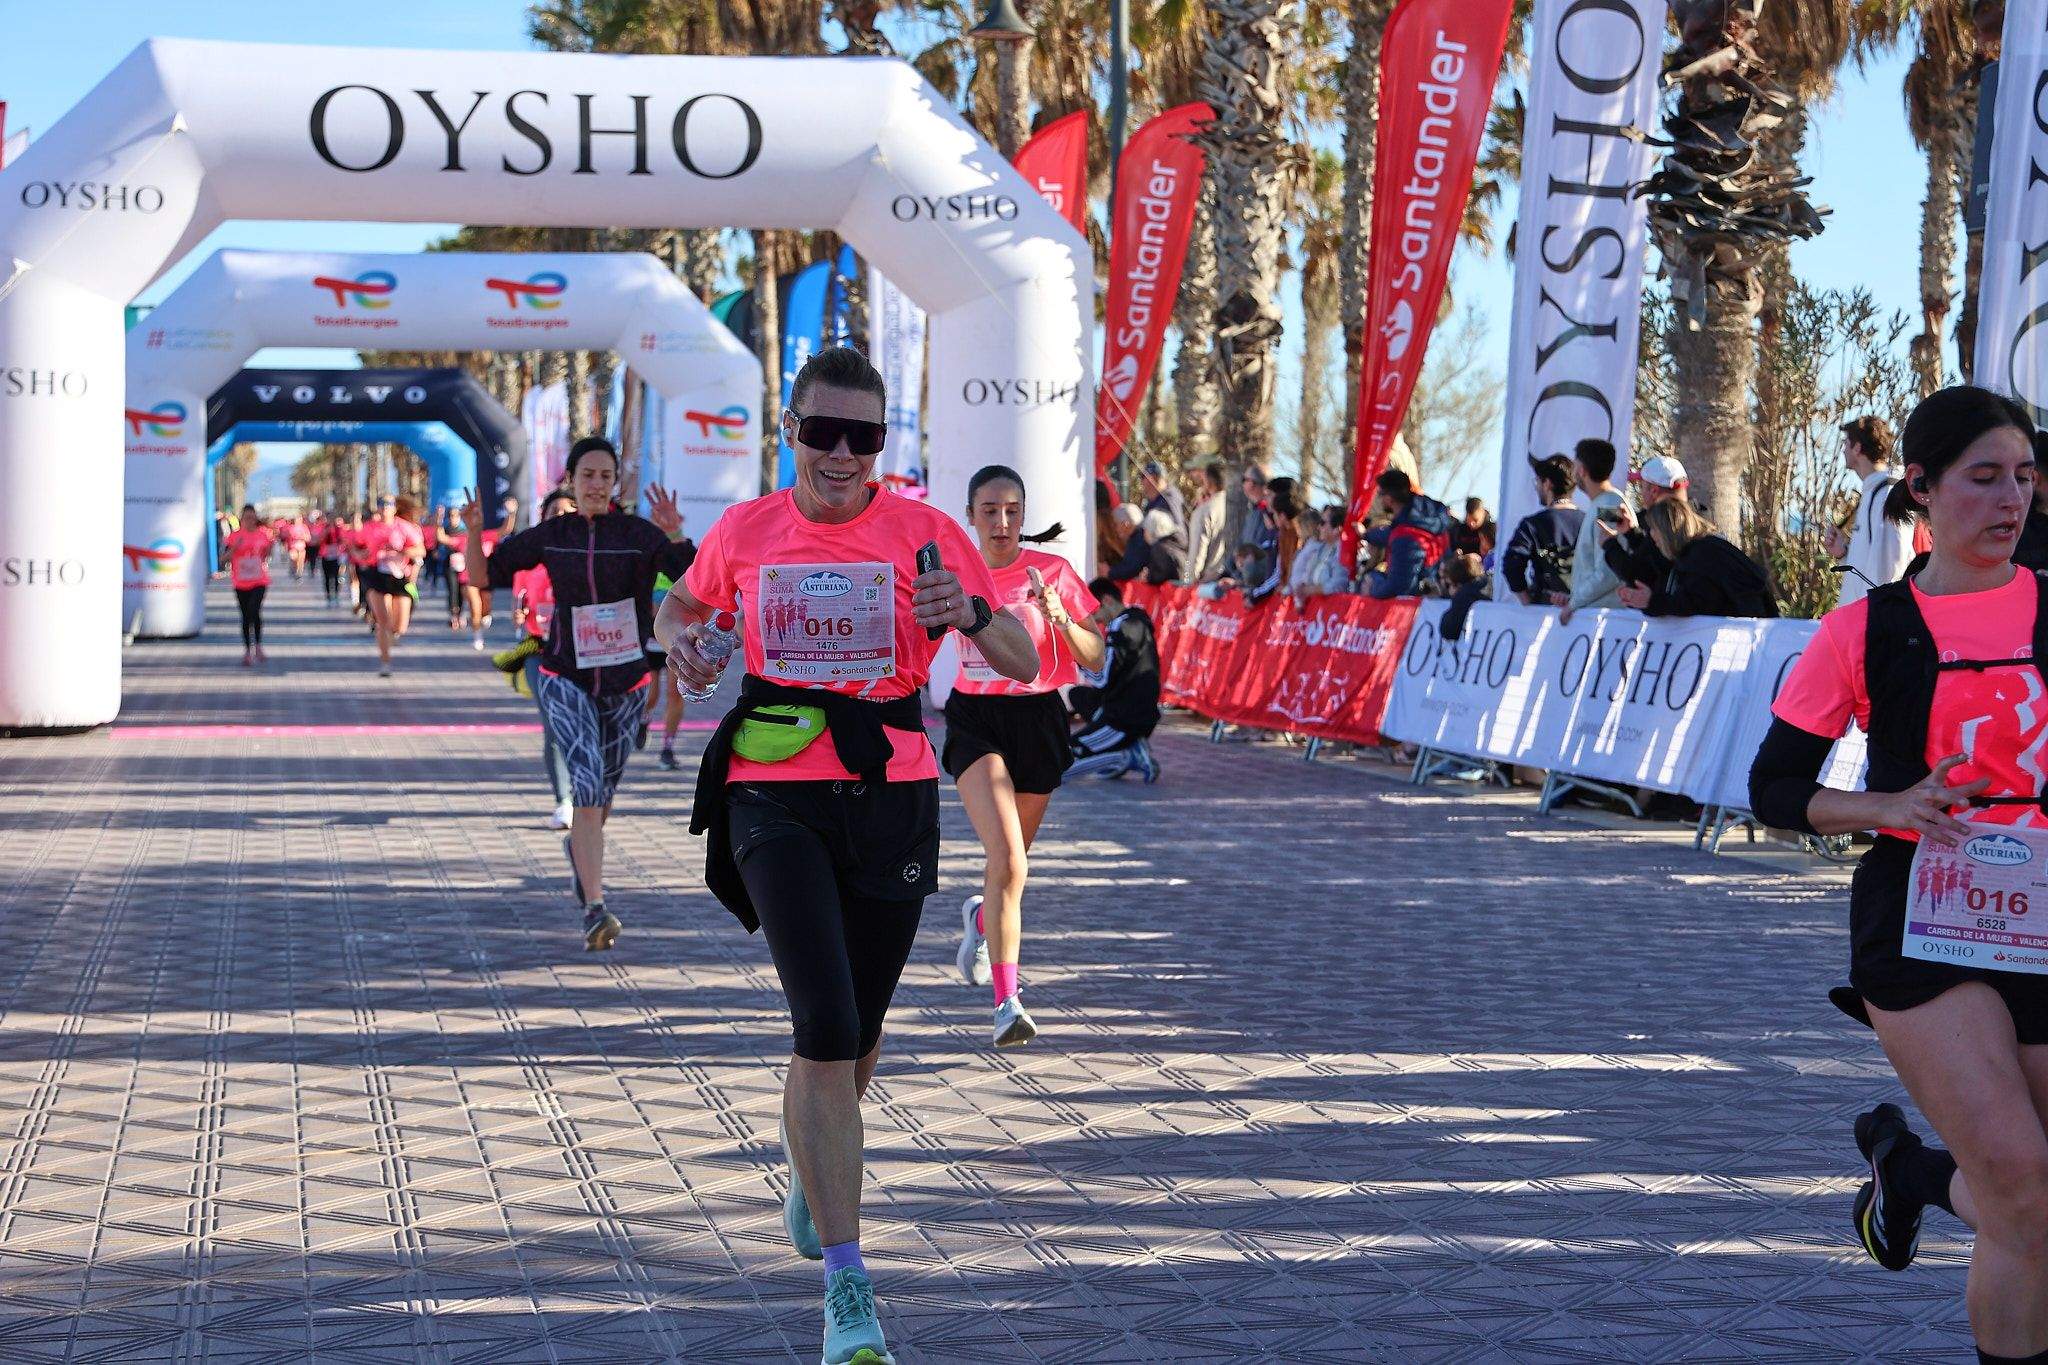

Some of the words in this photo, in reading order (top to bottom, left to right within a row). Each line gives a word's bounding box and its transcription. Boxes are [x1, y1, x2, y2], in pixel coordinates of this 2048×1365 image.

[310, 84, 763, 180] OYSHO
[1391, 29, 1468, 293] Santander
[22, 180, 165, 214] OYSHO
[892, 194, 1018, 223] OYSHO
[1528, 0, 1644, 464] OYSHO
[1117, 159, 1178, 351] Santander
[314, 316, 399, 329] TotalEnergies
[486, 316, 569, 329] TotalEnergies
[0, 367, 88, 397] SHO
[963, 378, 1080, 407] OYSHO
[252, 385, 428, 404] VOLVO
[0, 557, 86, 587] SHO
[803, 581, 849, 592] ASTURIANA
[597, 629, 623, 642] 016
[804, 617, 854, 636] 016
[816, 642, 838, 650] 1476
[849, 651, 878, 659] VALENCIA
[778, 665, 817, 675] OYSHO
[841, 666, 881, 675] Santander
[1559, 633, 1704, 711] OYSHO
[1969, 843, 2028, 860] ASTURIANA
[1966, 887, 2029, 916] 016
[1976, 918, 2006, 930] 6528
[1926, 926, 1961, 938] CARRERA
[1963, 930, 1973, 939] DE
[1975, 932, 1985, 940] LA
[1986, 933, 2013, 943] MUJER
[2019, 937, 2048, 947] VALENC
[1922, 941, 1975, 958] OYSHO
[2007, 953, 2048, 966] Santande
